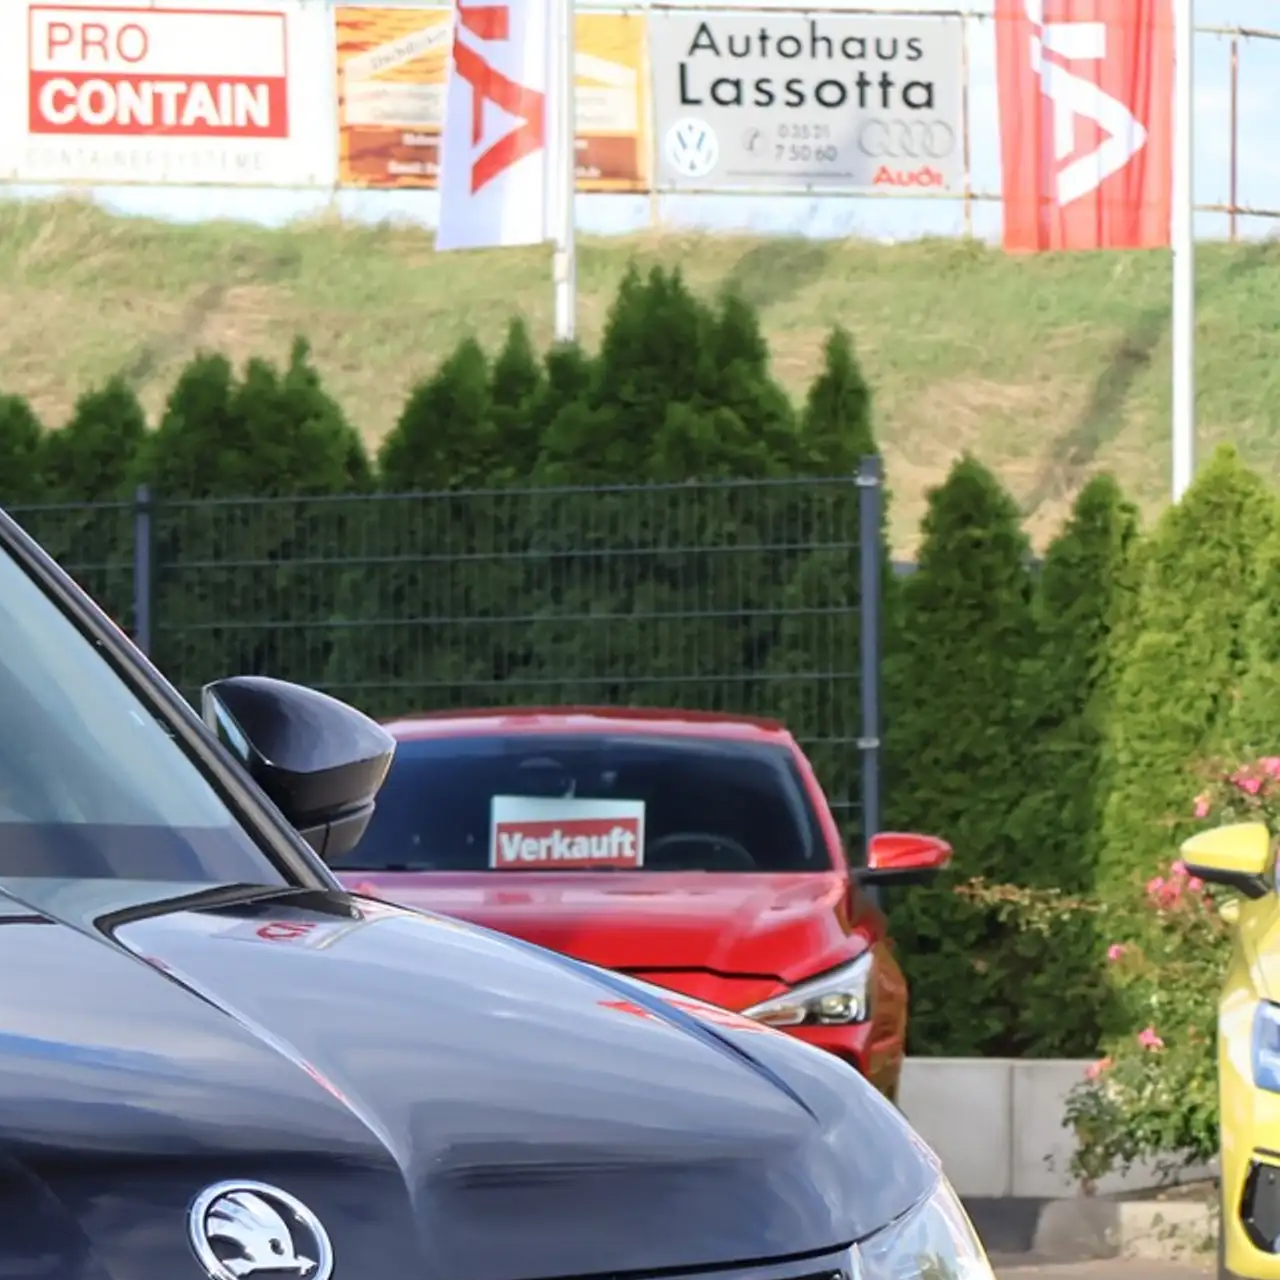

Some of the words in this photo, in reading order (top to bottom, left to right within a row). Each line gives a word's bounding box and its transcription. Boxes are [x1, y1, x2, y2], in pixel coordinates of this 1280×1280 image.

[47, 22, 148, 63] PRO
[688, 20, 924, 61] Autohaus
[38, 78, 269, 128] CONTAIN
[678, 62, 935, 109] Lassotta
[872, 165, 944, 187] Audi
[499, 825, 636, 861] Verkauft
